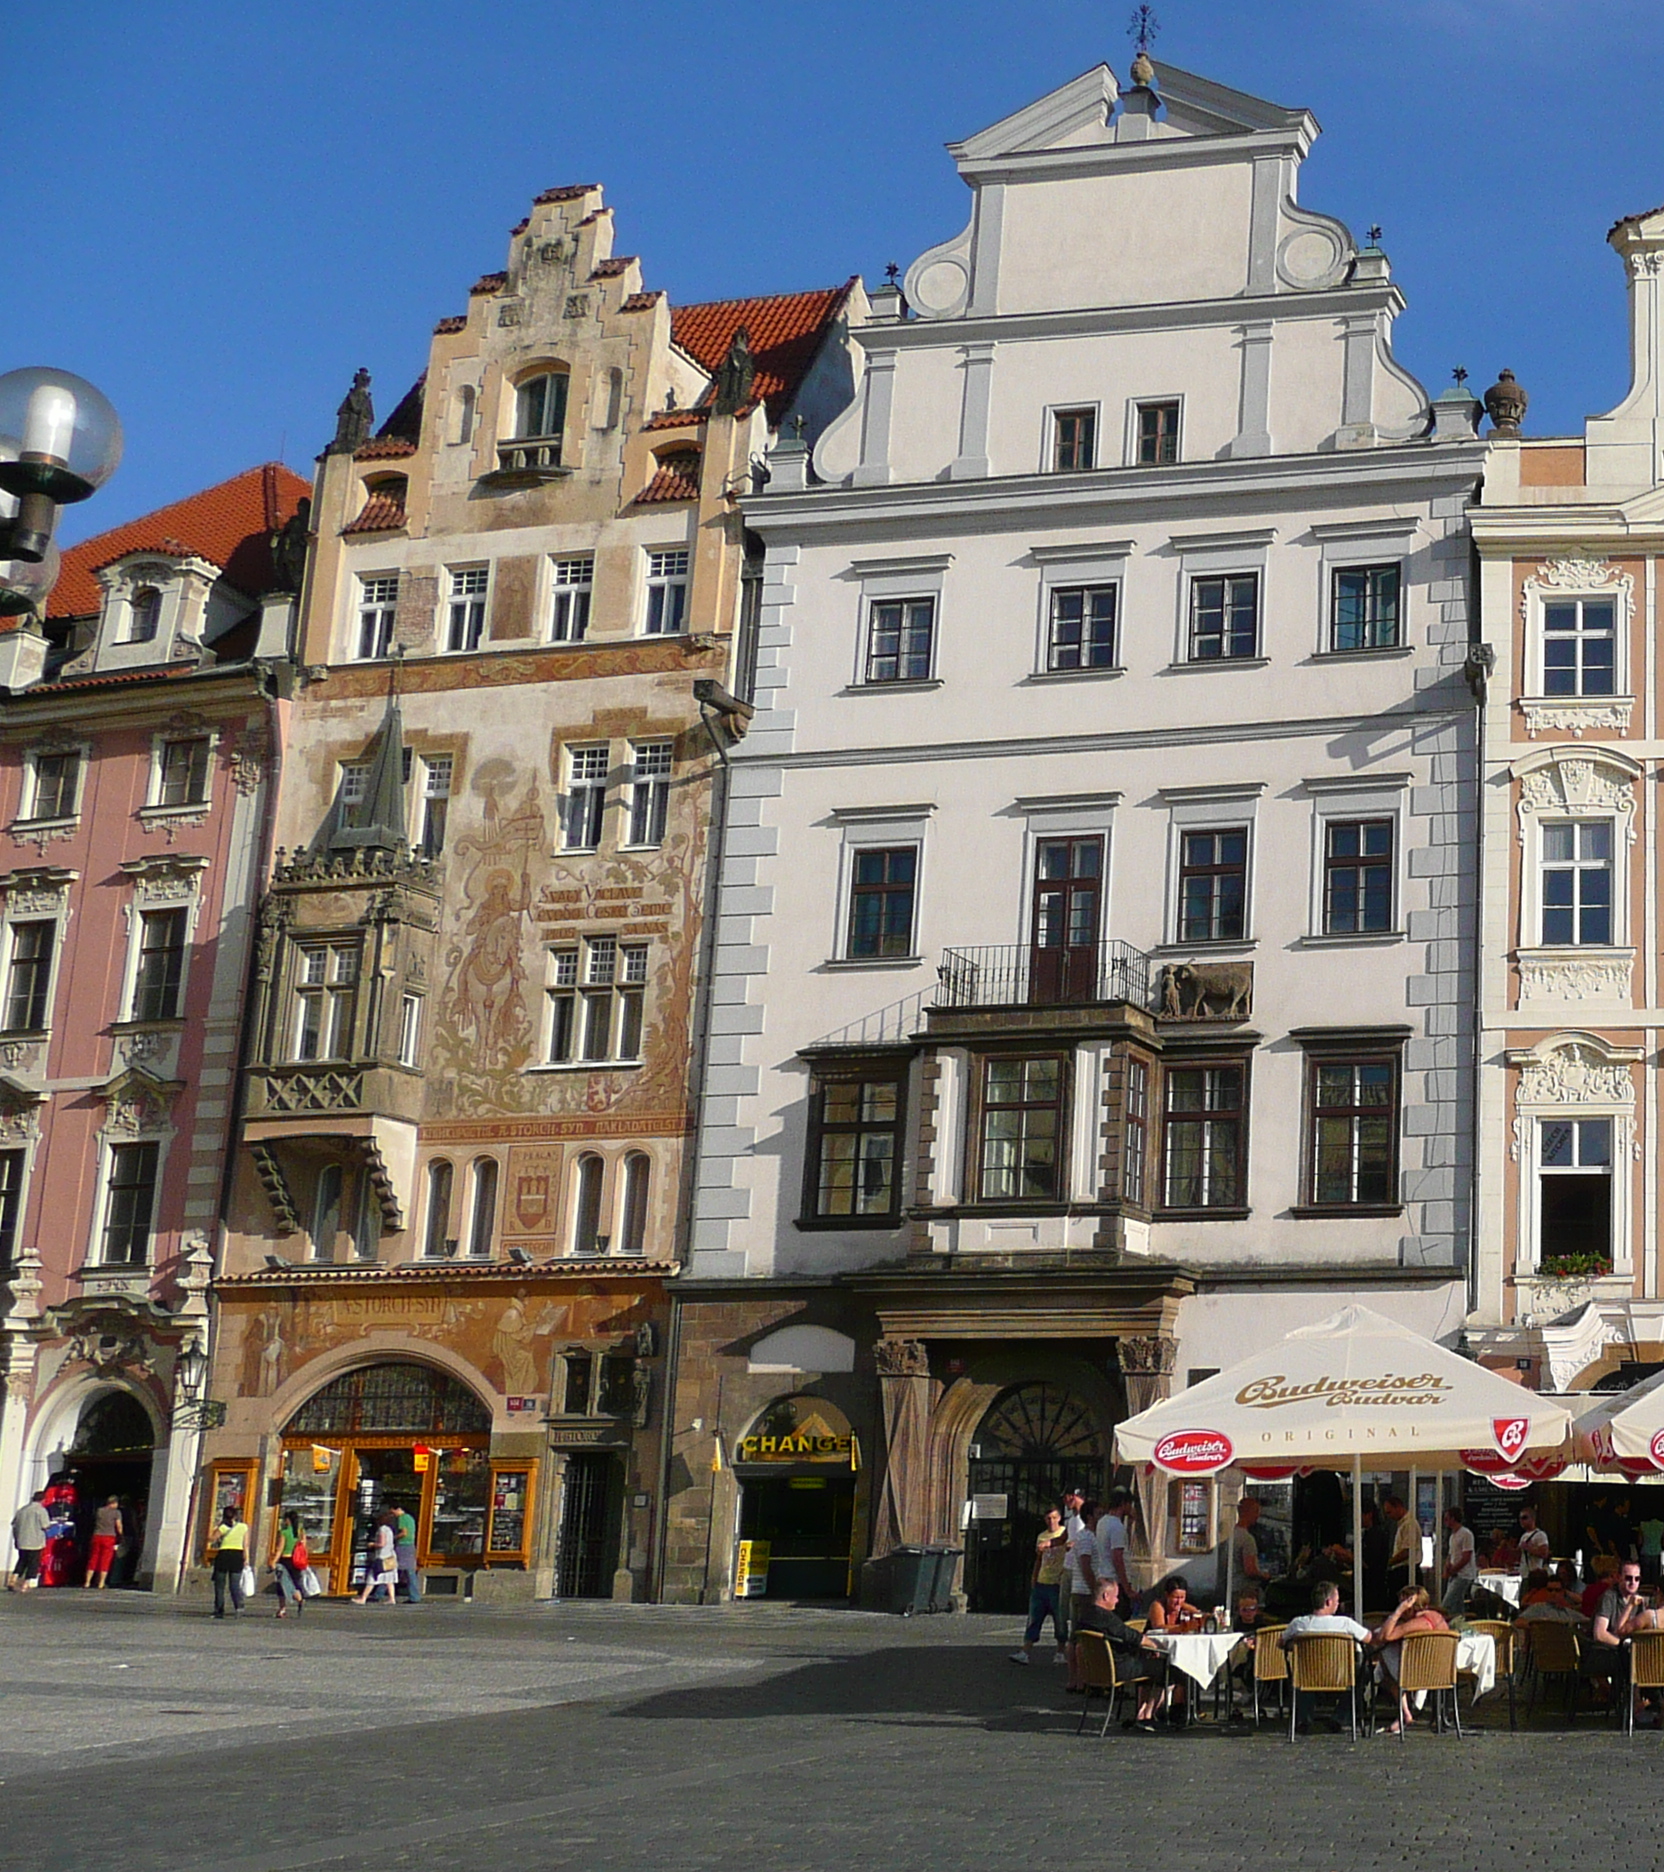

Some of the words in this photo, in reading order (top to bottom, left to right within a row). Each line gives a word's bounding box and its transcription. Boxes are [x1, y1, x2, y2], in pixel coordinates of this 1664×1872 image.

[1235, 1373, 1453, 1408] Budweiser
[1326, 1390, 1446, 1407] Budvar
[1261, 1426, 1420, 1442] ORIGINAL
[742, 1435, 850, 1453] CHANGE
[1158, 1438, 1227, 1461] Budweiser
[1186, 1451, 1225, 1462] Budvar
